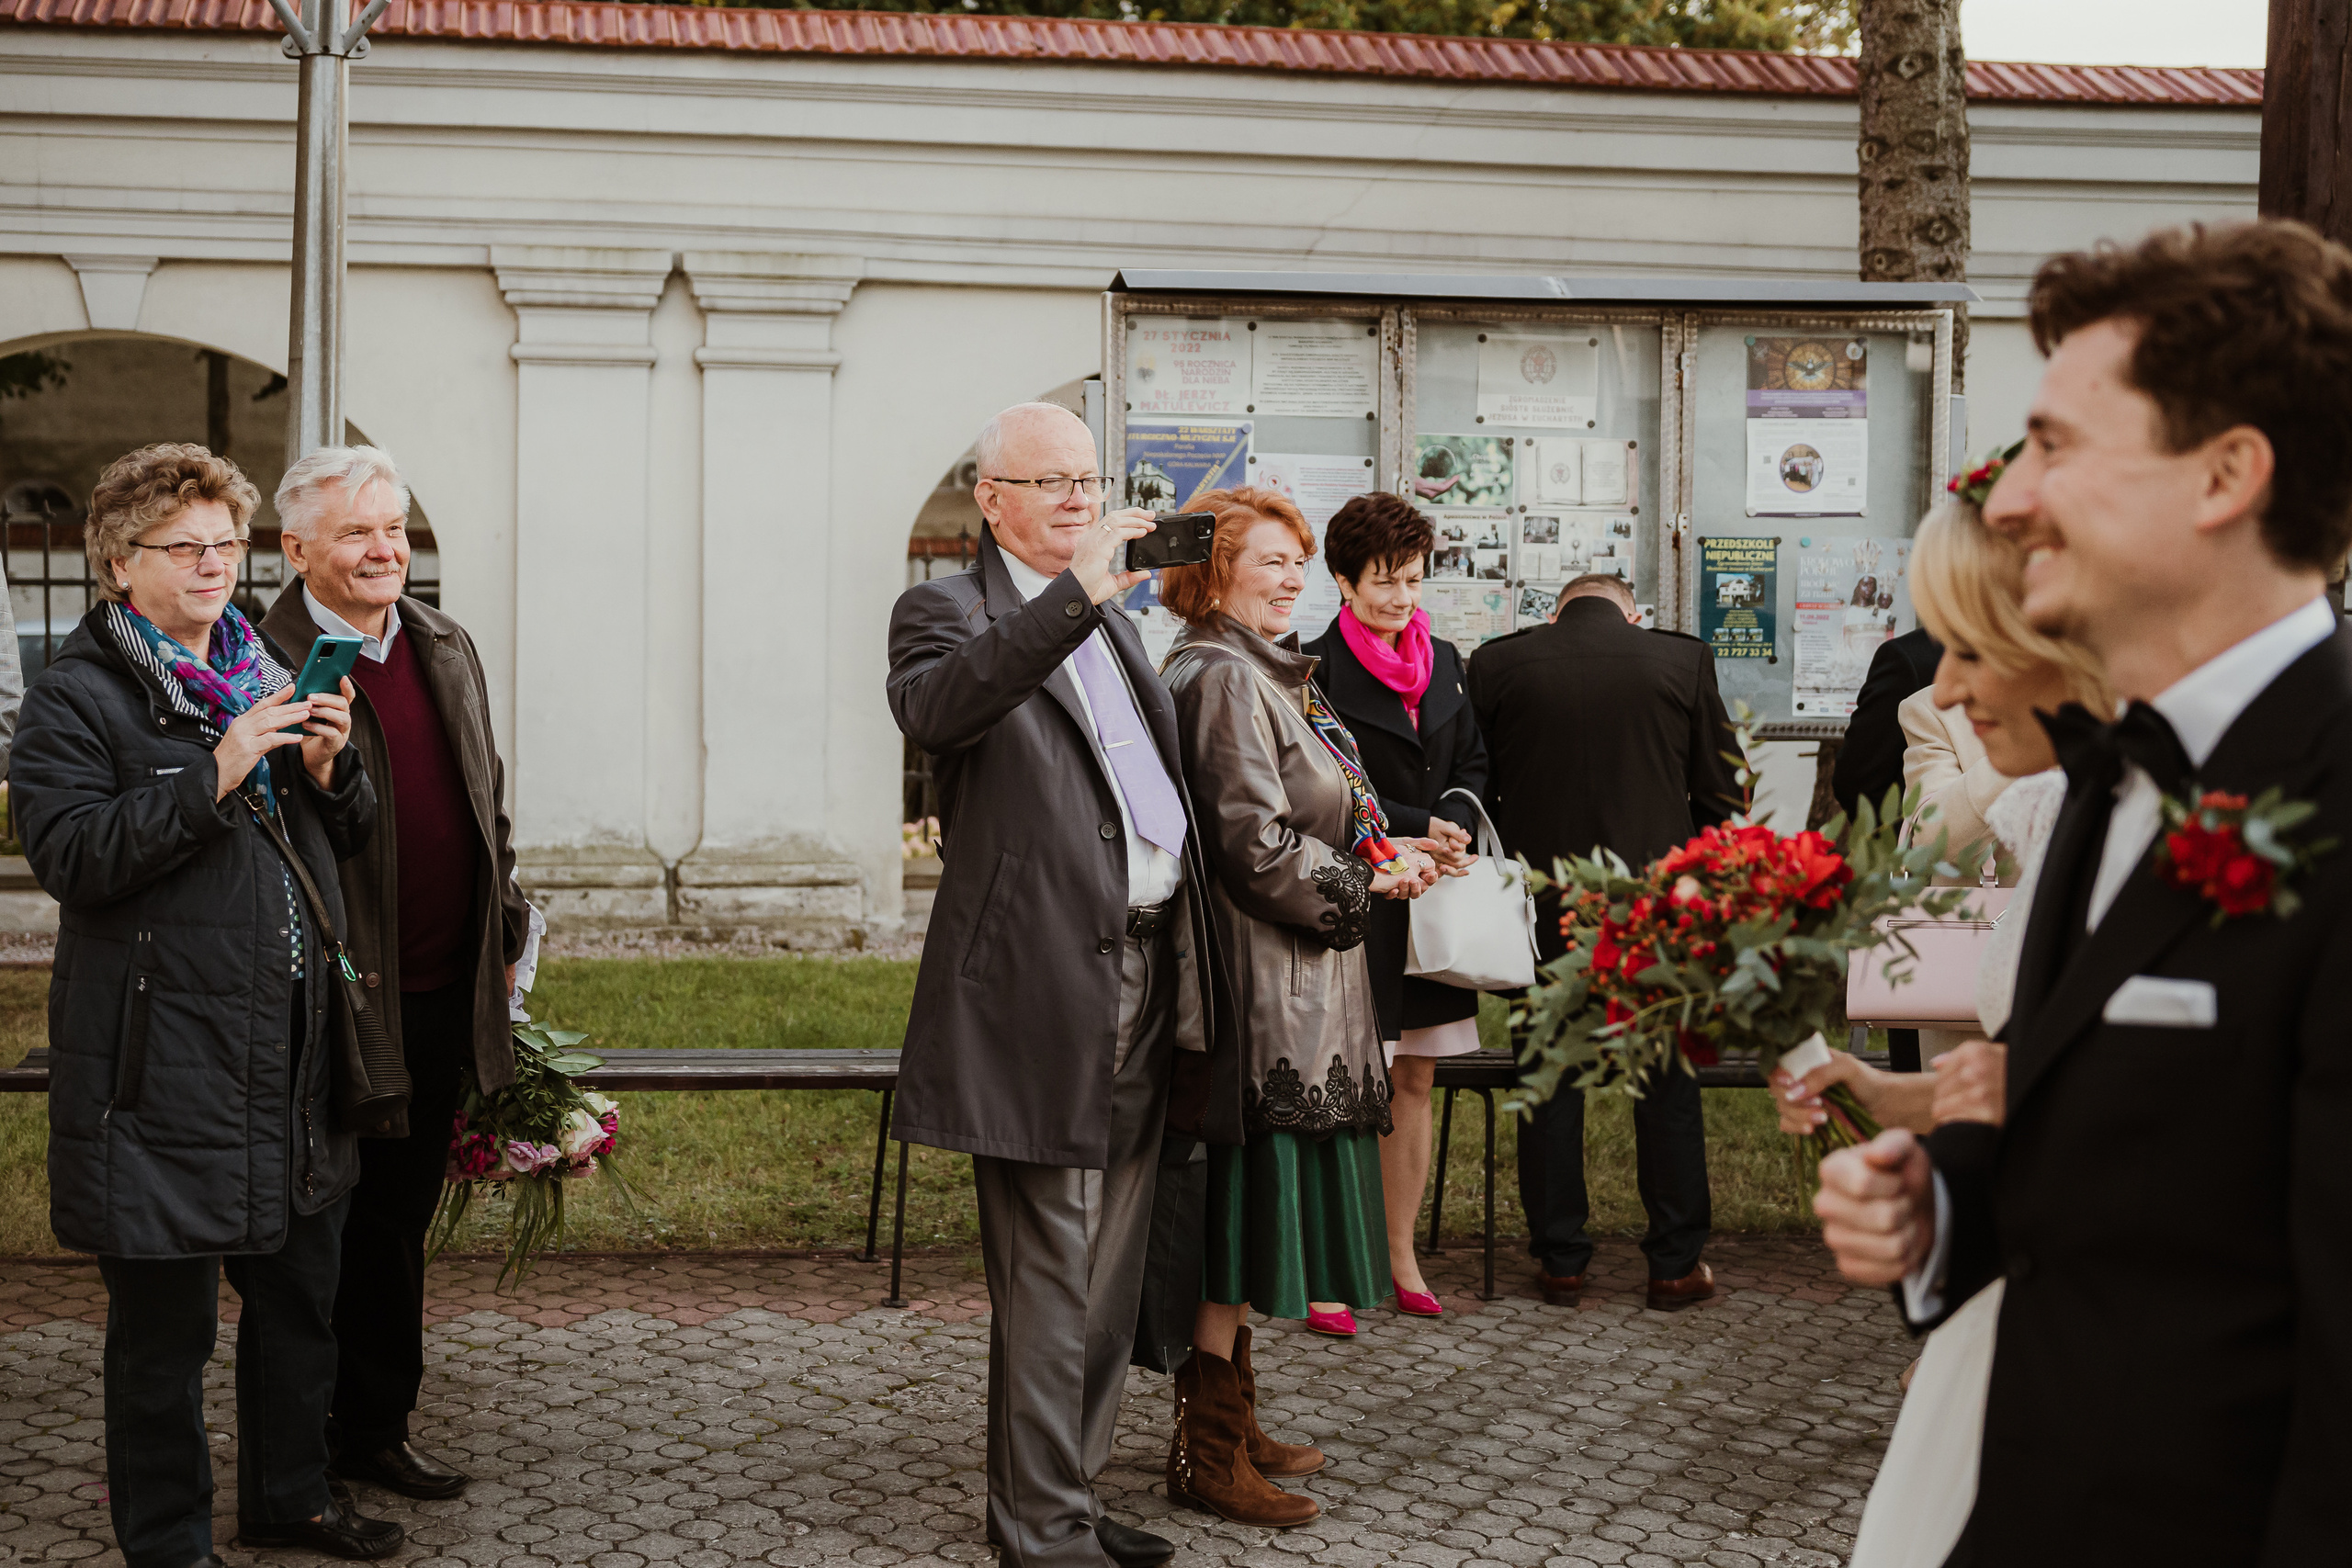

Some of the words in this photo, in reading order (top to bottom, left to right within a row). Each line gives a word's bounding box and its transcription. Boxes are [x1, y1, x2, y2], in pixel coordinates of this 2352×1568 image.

[1143, 331, 1157, 341] 27
[1162, 331, 1231, 342] STYCZNIA
[1170, 343, 1202, 353] 2022
[1173, 360, 1185, 368] 95
[1187, 360, 1237, 368] ROCZNICA
[1181, 367, 1231, 376] NARODZIN
[1182, 376, 1201, 384] DLA
[1202, 377, 1230, 385] NIEBA
[1179, 389, 1216, 400] JERZY
[1509, 395, 1566, 404] ZGROMADZENIE
[1139, 401, 1230, 412] MATULEWICZ
[1487, 412, 1517, 421] JEZUSA
[1704, 538, 1774, 550] PRZEDSZKOLE
[1705, 550, 1775, 561] NIEPUBLICZNE
[1717, 648, 1729, 657] 22
[1731, 648, 1747, 657] 727
[1748, 648, 1760, 657] 33
[1761, 648, 1773, 657] 34
